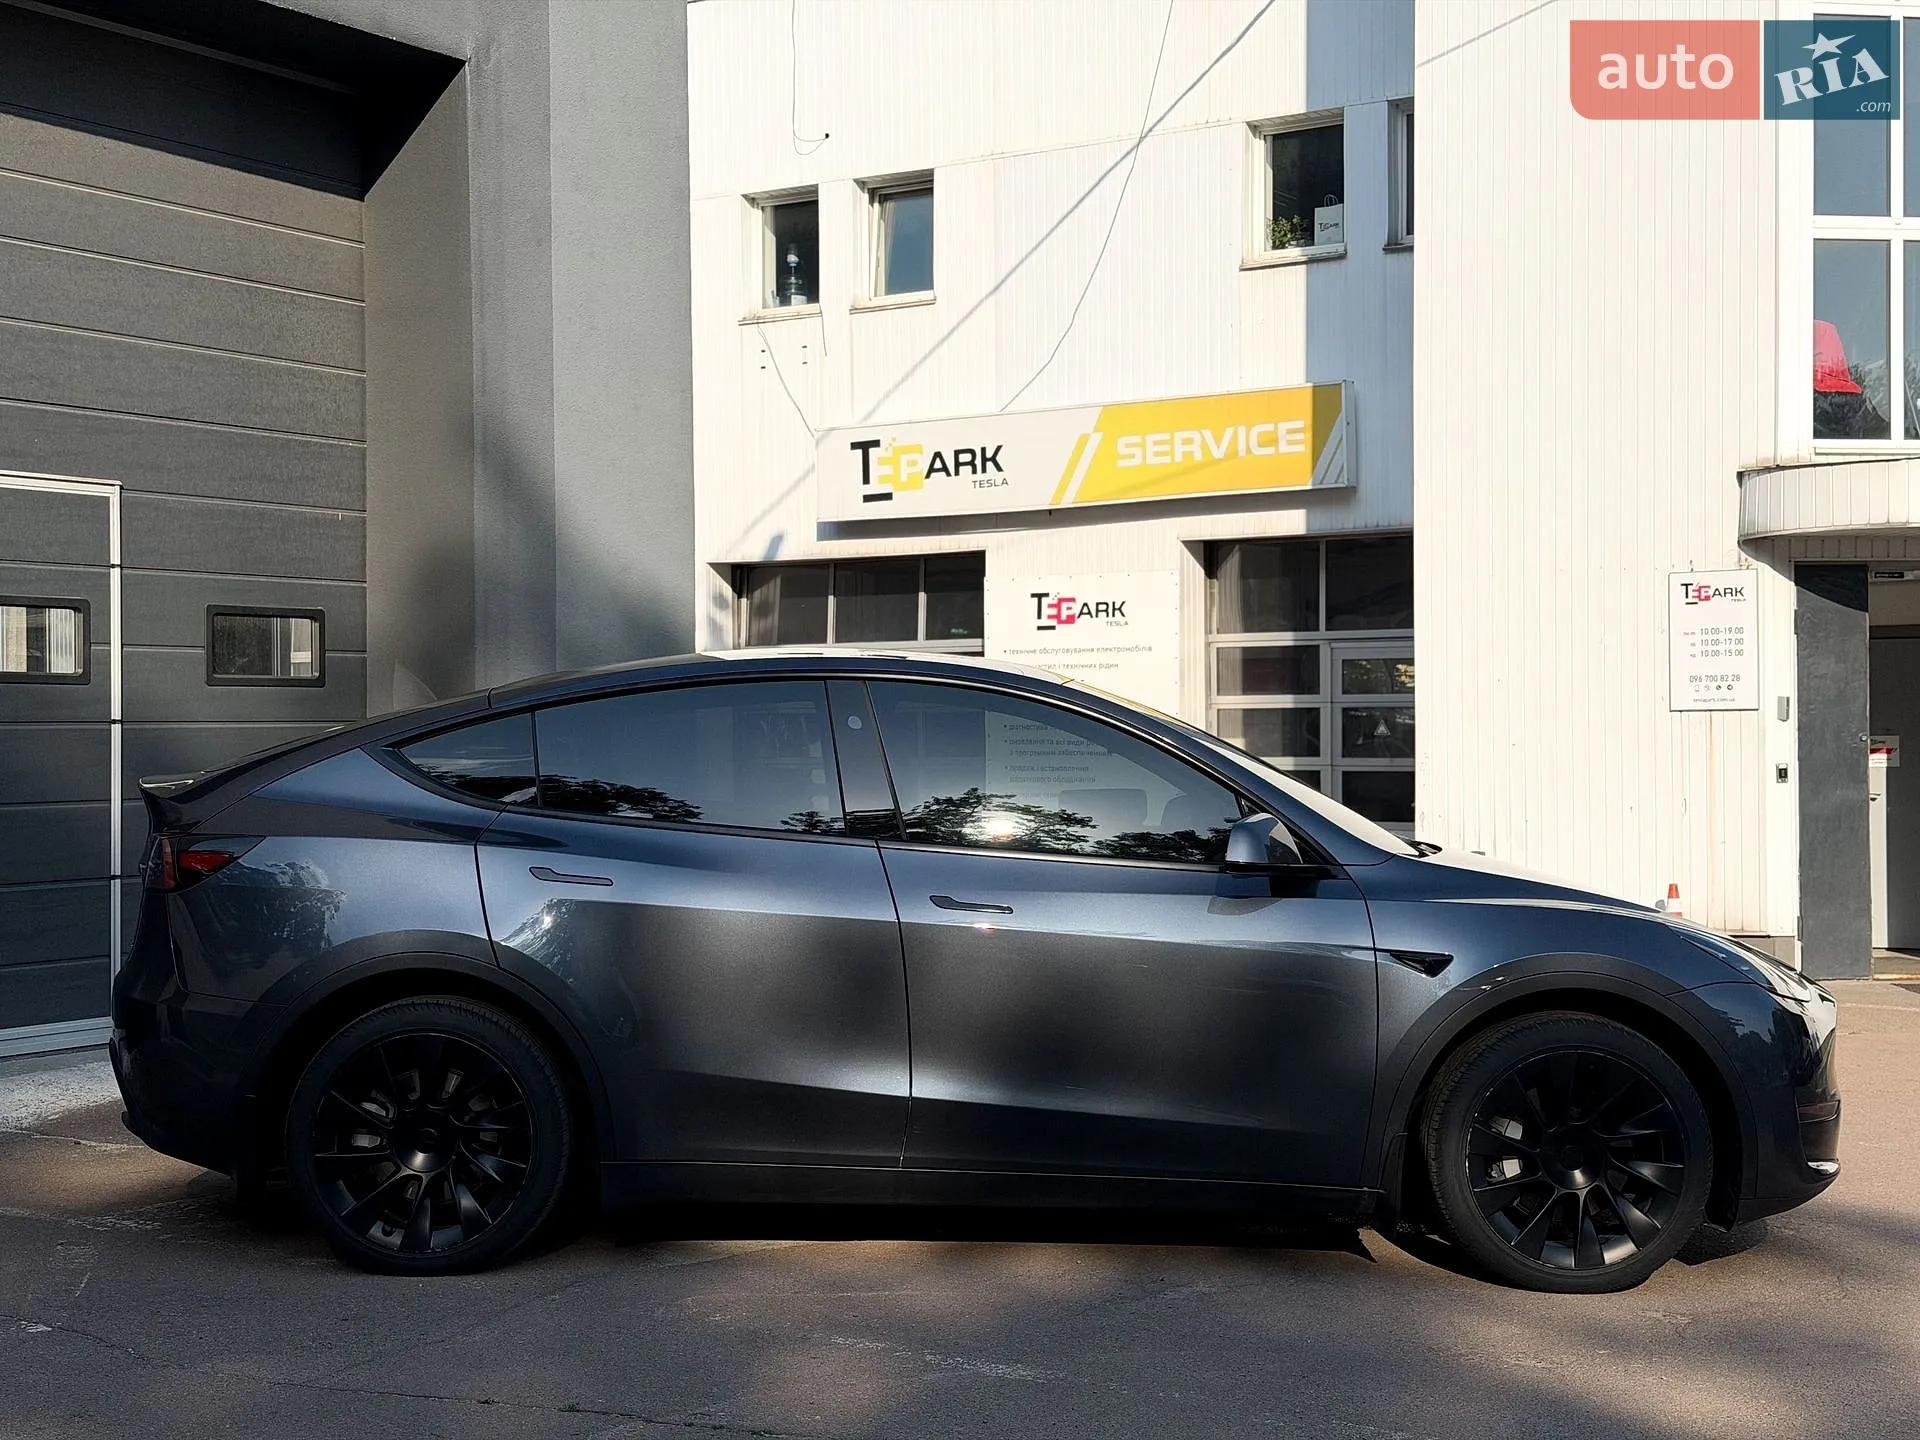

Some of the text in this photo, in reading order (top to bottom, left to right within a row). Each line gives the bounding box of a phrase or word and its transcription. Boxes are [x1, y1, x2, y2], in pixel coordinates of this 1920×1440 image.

[1116, 420, 1306, 467] SERVICE
[972, 477, 1009, 490] TESLA
[1106, 620, 1129, 628] TESLA
